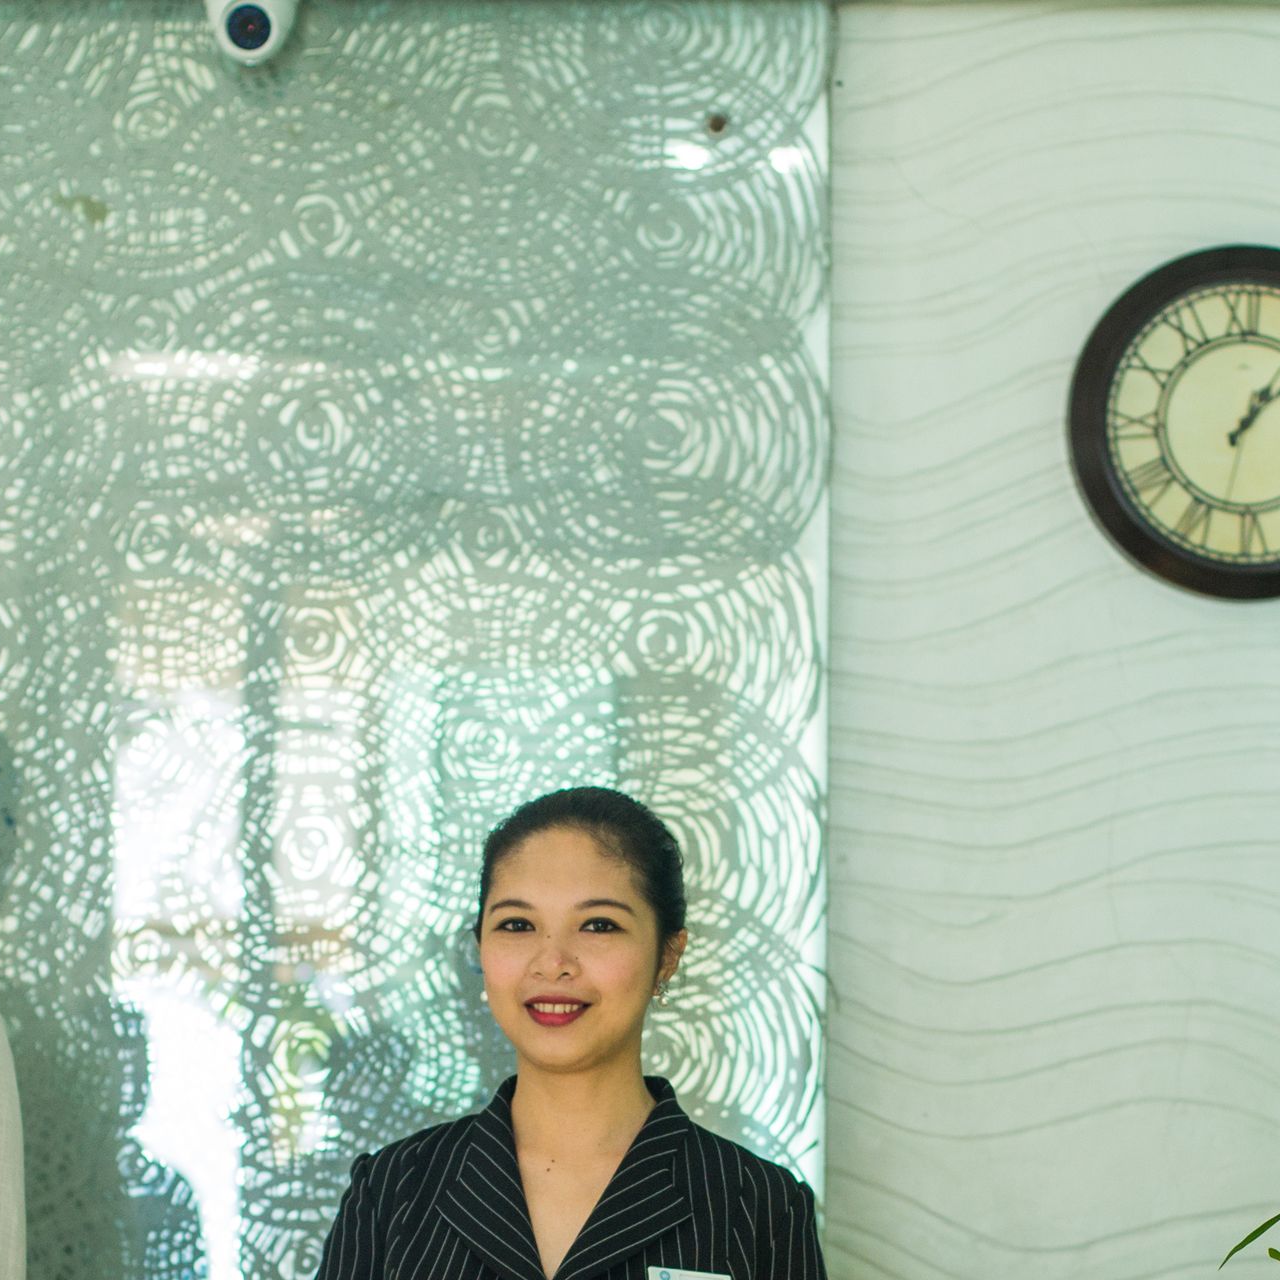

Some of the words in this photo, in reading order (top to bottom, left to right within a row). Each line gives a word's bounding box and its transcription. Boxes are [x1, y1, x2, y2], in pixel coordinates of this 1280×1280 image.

[1162, 302, 1208, 354] XI
[1222, 291, 1261, 335] XII
[1126, 352, 1171, 389] X
[1112, 411, 1159, 439] IX
[1174, 499, 1213, 548] VII
[1239, 507, 1269, 555] VI
